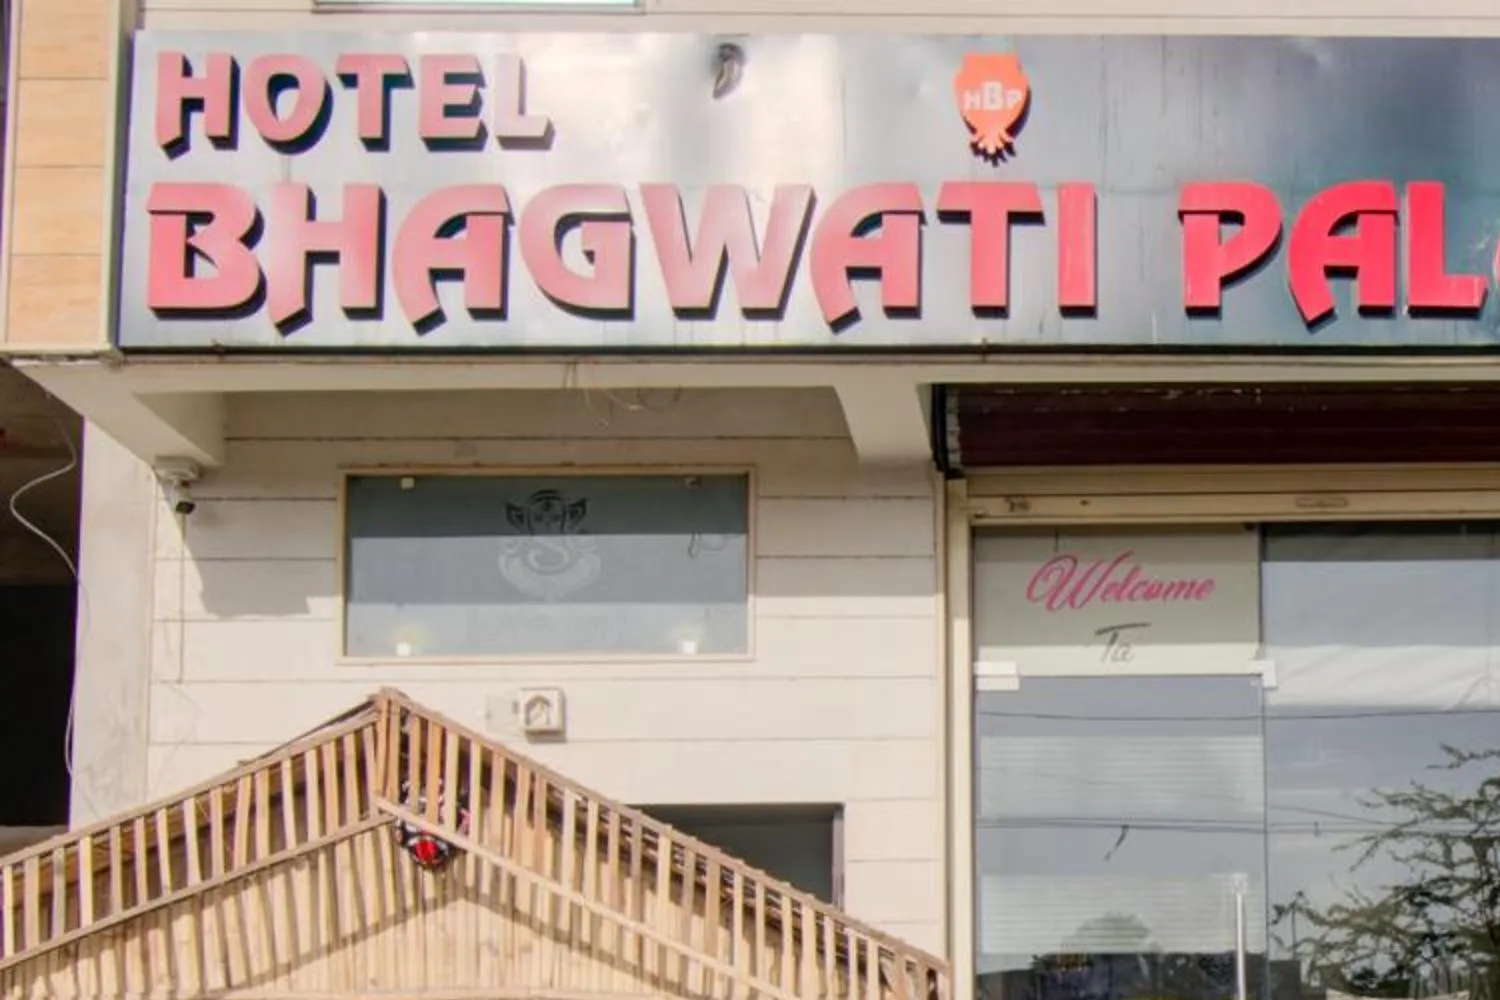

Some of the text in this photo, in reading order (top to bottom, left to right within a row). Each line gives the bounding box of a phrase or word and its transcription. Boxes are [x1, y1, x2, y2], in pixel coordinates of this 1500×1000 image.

[155, 52, 554, 158] HOTEL
[963, 81, 1023, 110] HBP
[147, 182, 1097, 334] BHAGWATI
[1026, 550, 1215, 611] Welcome
